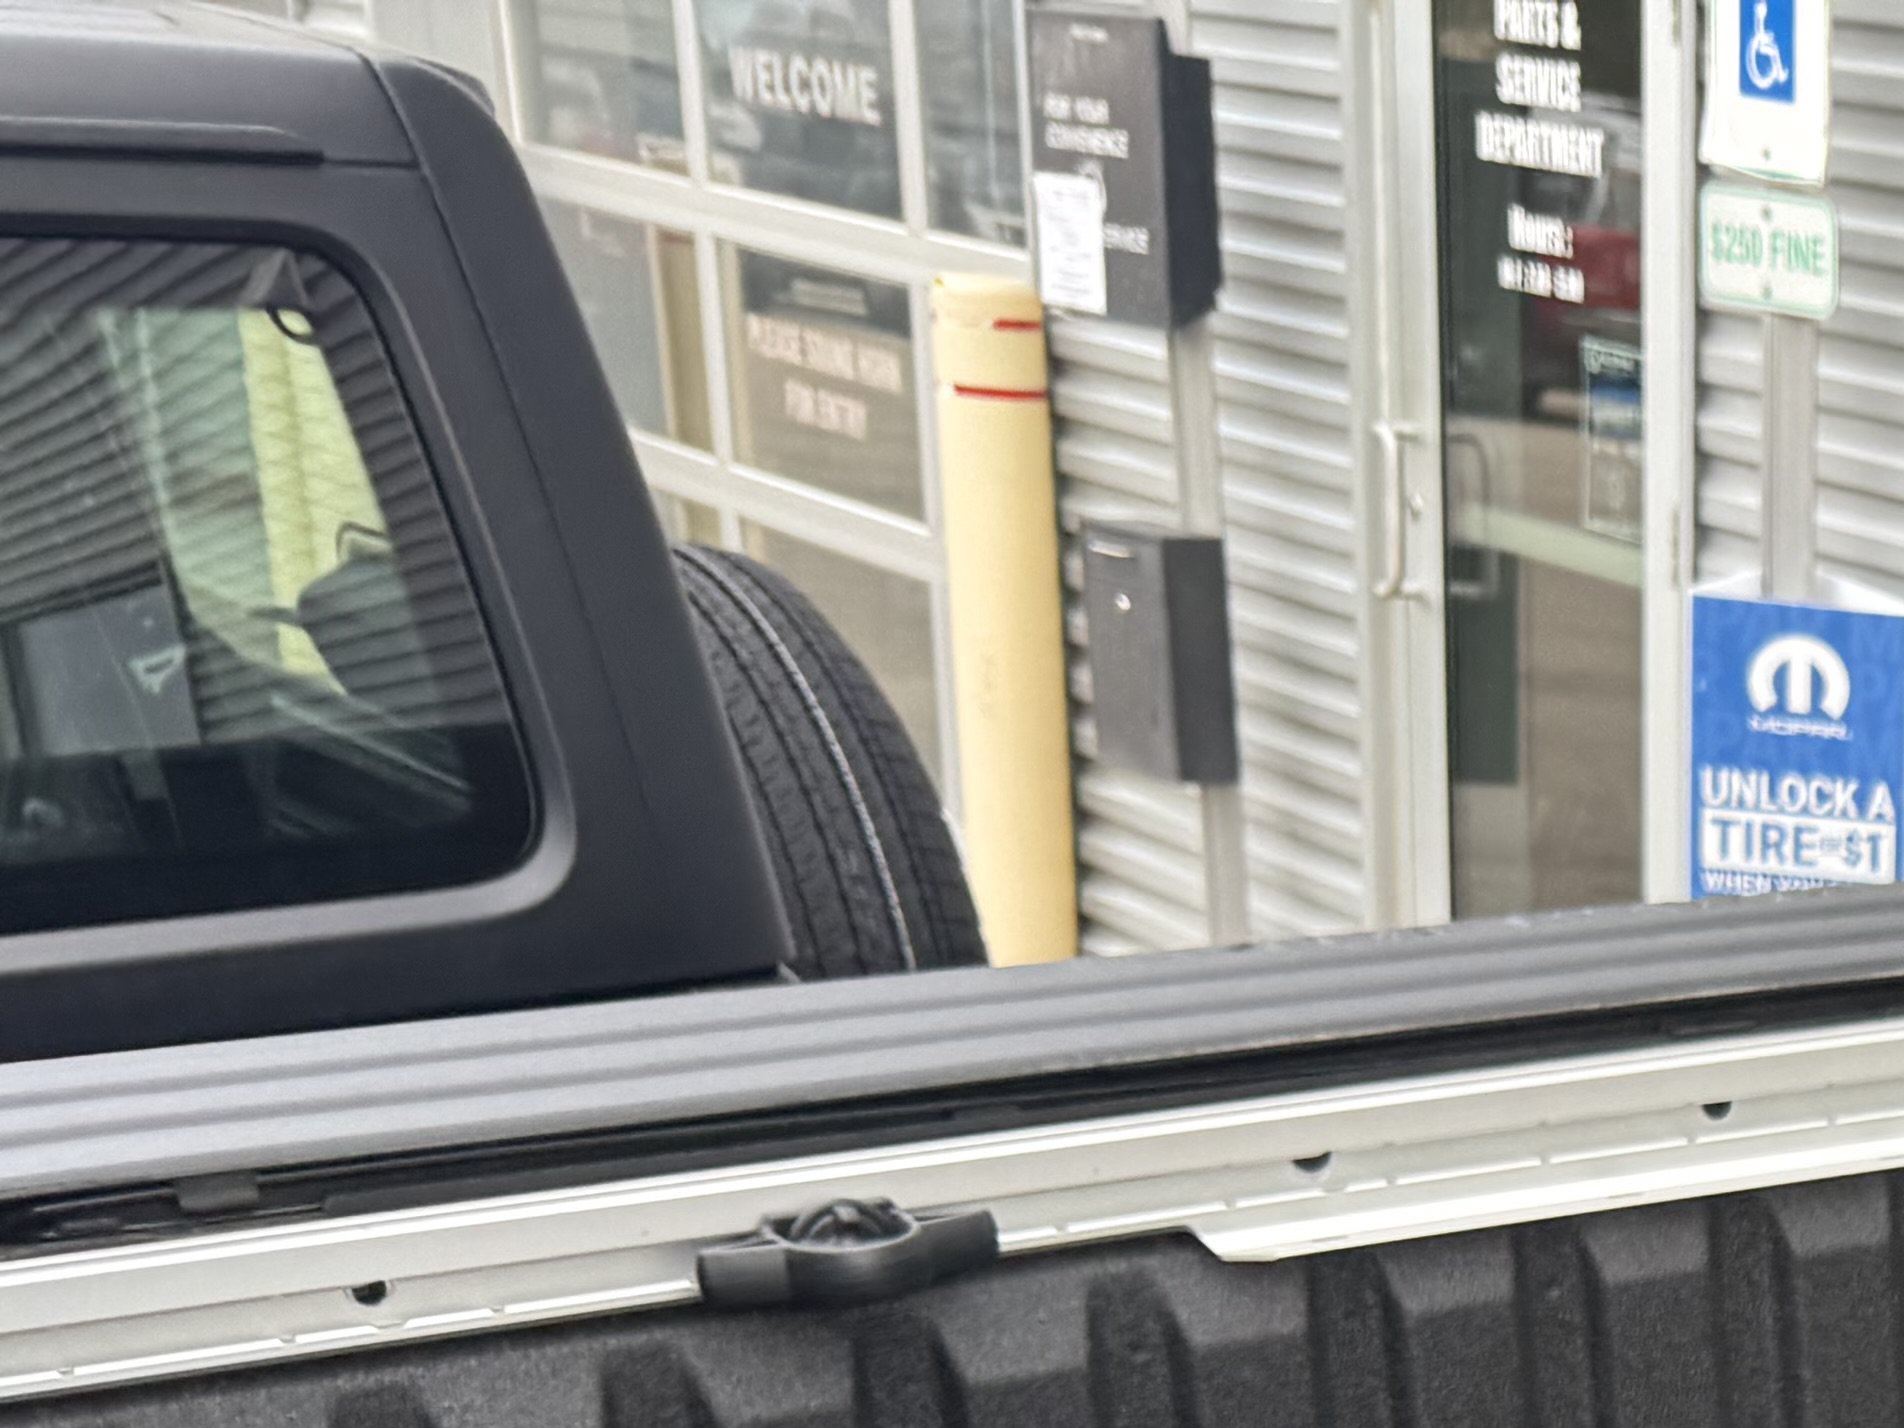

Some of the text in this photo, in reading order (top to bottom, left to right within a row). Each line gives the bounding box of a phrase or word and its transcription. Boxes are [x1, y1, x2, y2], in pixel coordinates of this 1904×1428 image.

[1494, 0, 1582, 50] PARTS &
[728, 46, 883, 126] WELCOME
[1495, 53, 1582, 112] SERVICE
[1475, 110, 1604, 178] DEPARTMENT
[1711, 221, 1826, 278] $250 FINE
[1700, 765, 1897, 824] UNLOCK A
[1708, 818, 1887, 873] TIRE $1
[1702, 868, 1773, 896] WHEN
